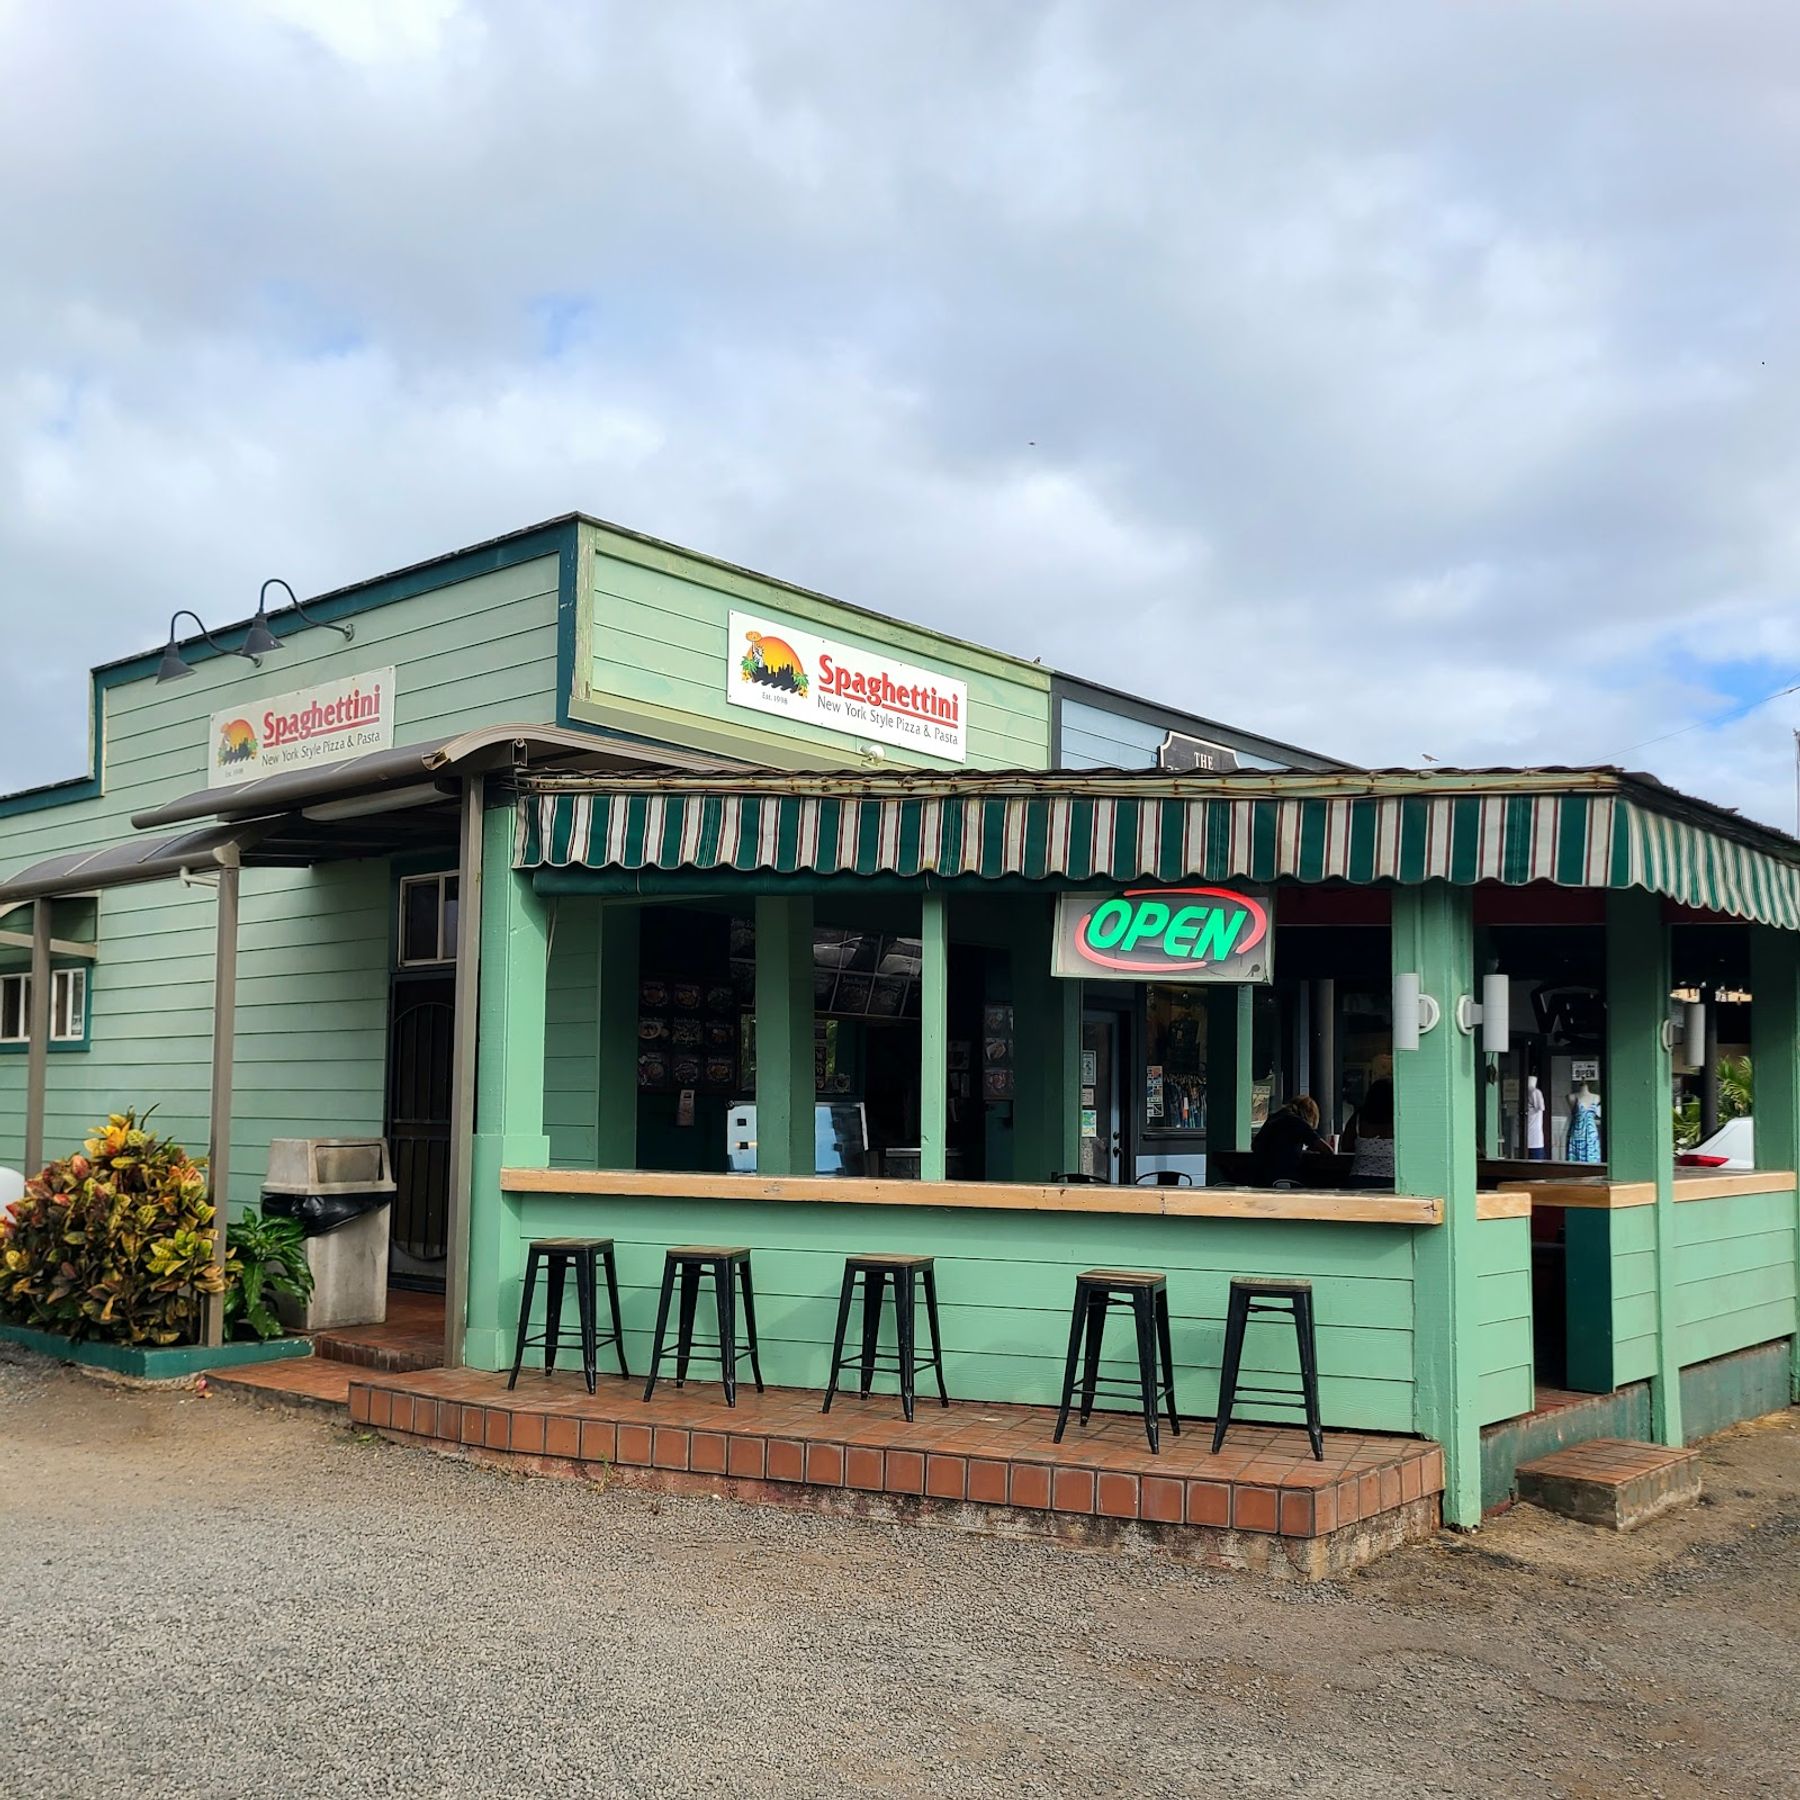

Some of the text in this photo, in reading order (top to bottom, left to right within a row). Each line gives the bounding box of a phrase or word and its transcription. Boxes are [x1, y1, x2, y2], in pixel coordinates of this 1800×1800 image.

[263, 684, 381, 746] Spaghettini
[818, 654, 959, 722] Spaghettini
[817, 694, 958, 745] New York Style Pizza & Pasta
[261, 731, 381, 767] New York Style Pizza & Pasta
[1193, 751, 1214, 771] THE
[1087, 898, 1248, 962] OPEN
